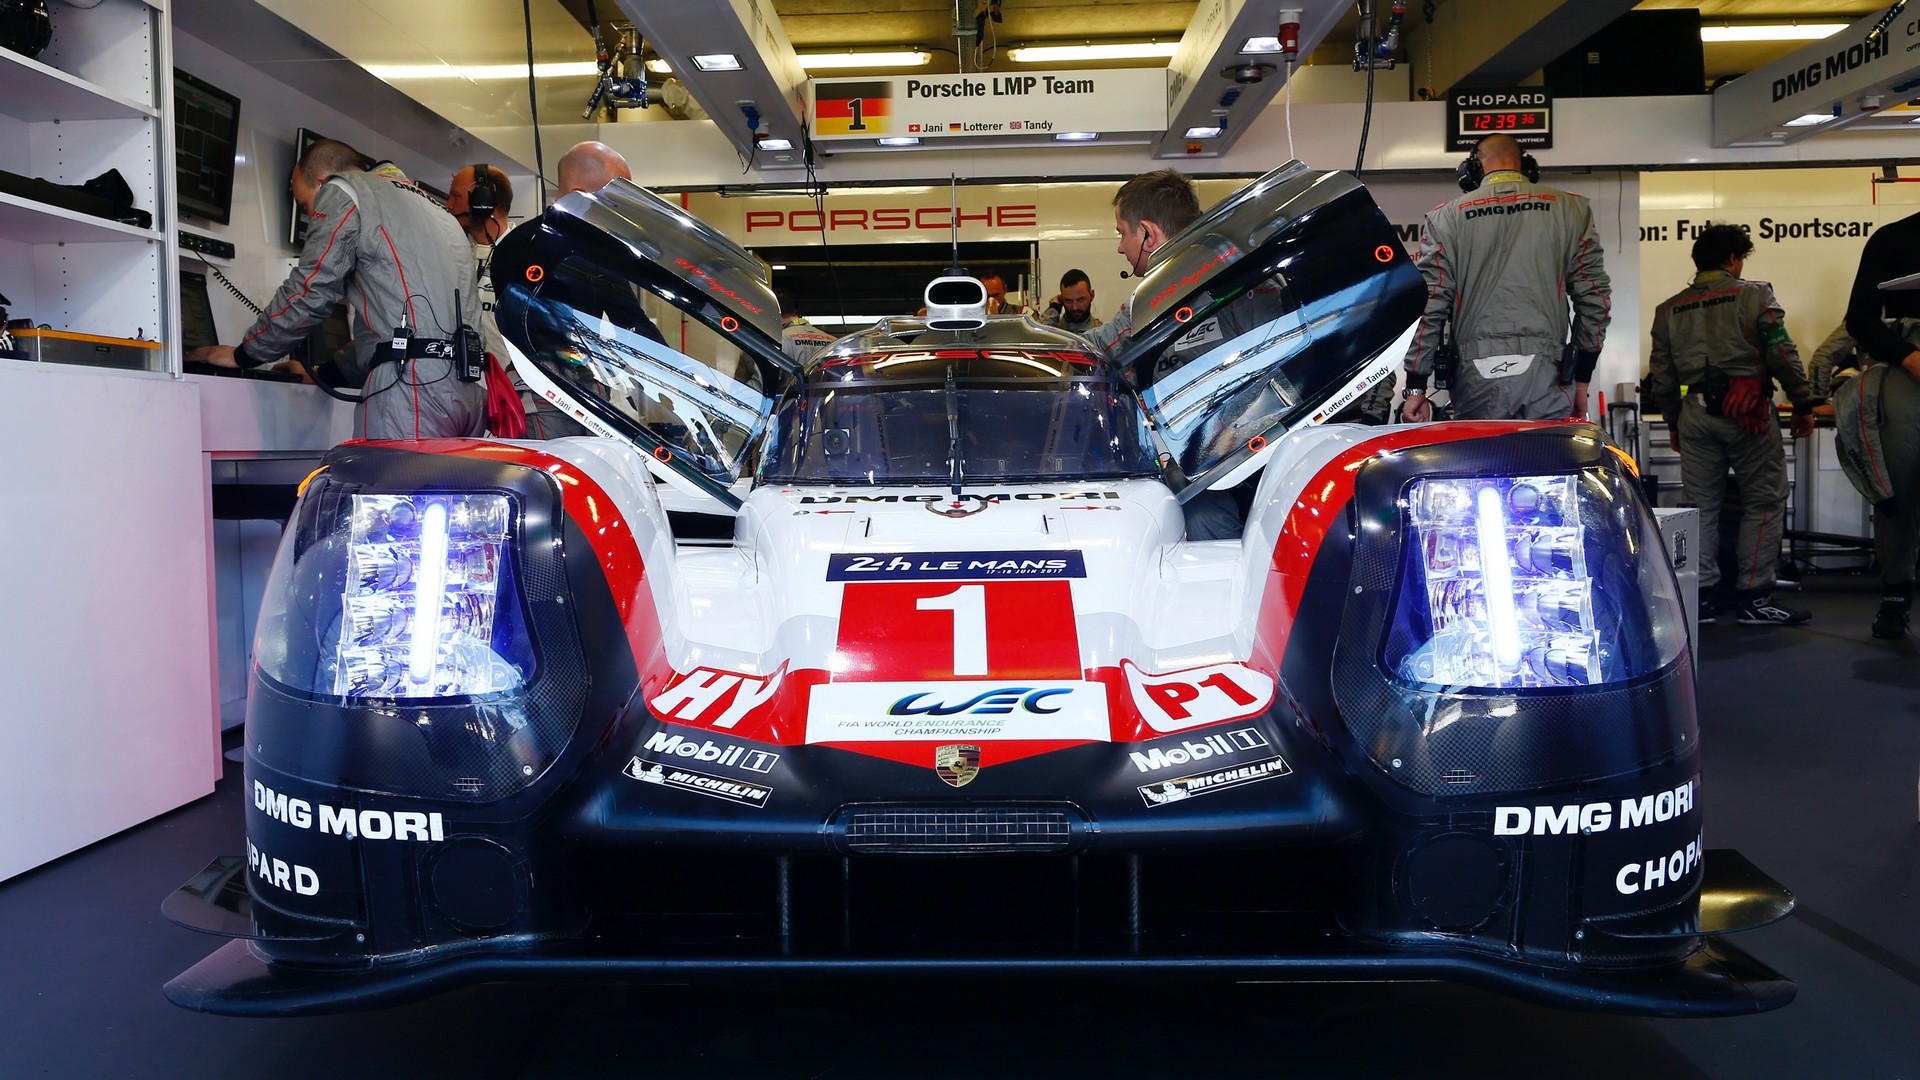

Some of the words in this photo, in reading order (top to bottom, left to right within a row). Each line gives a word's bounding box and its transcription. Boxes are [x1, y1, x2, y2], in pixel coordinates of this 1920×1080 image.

[1772, 62, 1822, 103] DMG
[1825, 31, 1889, 80] MORI
[907, 78, 986, 98] Porsche
[993, 76, 1036, 96] LMP
[1042, 76, 1094, 94] Team
[1457, 94, 1545, 106] CHOPARD
[848, 98, 866, 131] 1
[923, 123, 943, 133] Jani
[963, 122, 1003, 131] Lotterer
[1024, 121, 1053, 132] Tandy
[1474, 115, 1492, 129] 12
[1496, 114, 1517, 129] 39
[1521, 113, 1535, 124] 36
[1458, 193, 1557, 212] PORSCHE
[1465, 202, 1505, 220] DMG
[1507, 201, 1550, 215] MORI
[746, 205, 1036, 232] PORSCHE
[1759, 217, 1873, 243] Sportscar
[818, 350, 1097, 371] PORSCHE
[1322, 391, 1354, 417] Lotterer
[1366, 364, 1390, 384] Tandy
[555, 397, 572, 412] Jani
[583, 415, 614, 439] Lotterer
[800, 495, 943, 504] DMG
[957, 491, 1119, 502] MORI
[919, 560, 963, 570] LE
[967, 559, 1068, 570] MANS
[916, 585, 988, 675] 1
[650, 668, 785, 729] HY
[886, 687, 1074, 716] WEC
[1141, 673, 1258, 720] P1
[837, 720, 860, 728] FIA
[864, 720, 913, 728] WORLD
[915, 719, 1006, 727] ENDURANCE
[894, 727, 1001, 736] CHAMPIONSHIP
[644, 731, 745, 766] Mobil
[1129, 734, 1234, 773] Mobil
[667, 771, 767, 800] MICHELIN
[1187, 759, 1283, 790] MICHELIN
[254, 779, 312, 829] DMG
[318, 804, 444, 841] MORI
[1494, 802, 1612, 836] DMG
[1620, 780, 1693, 829] MORI
